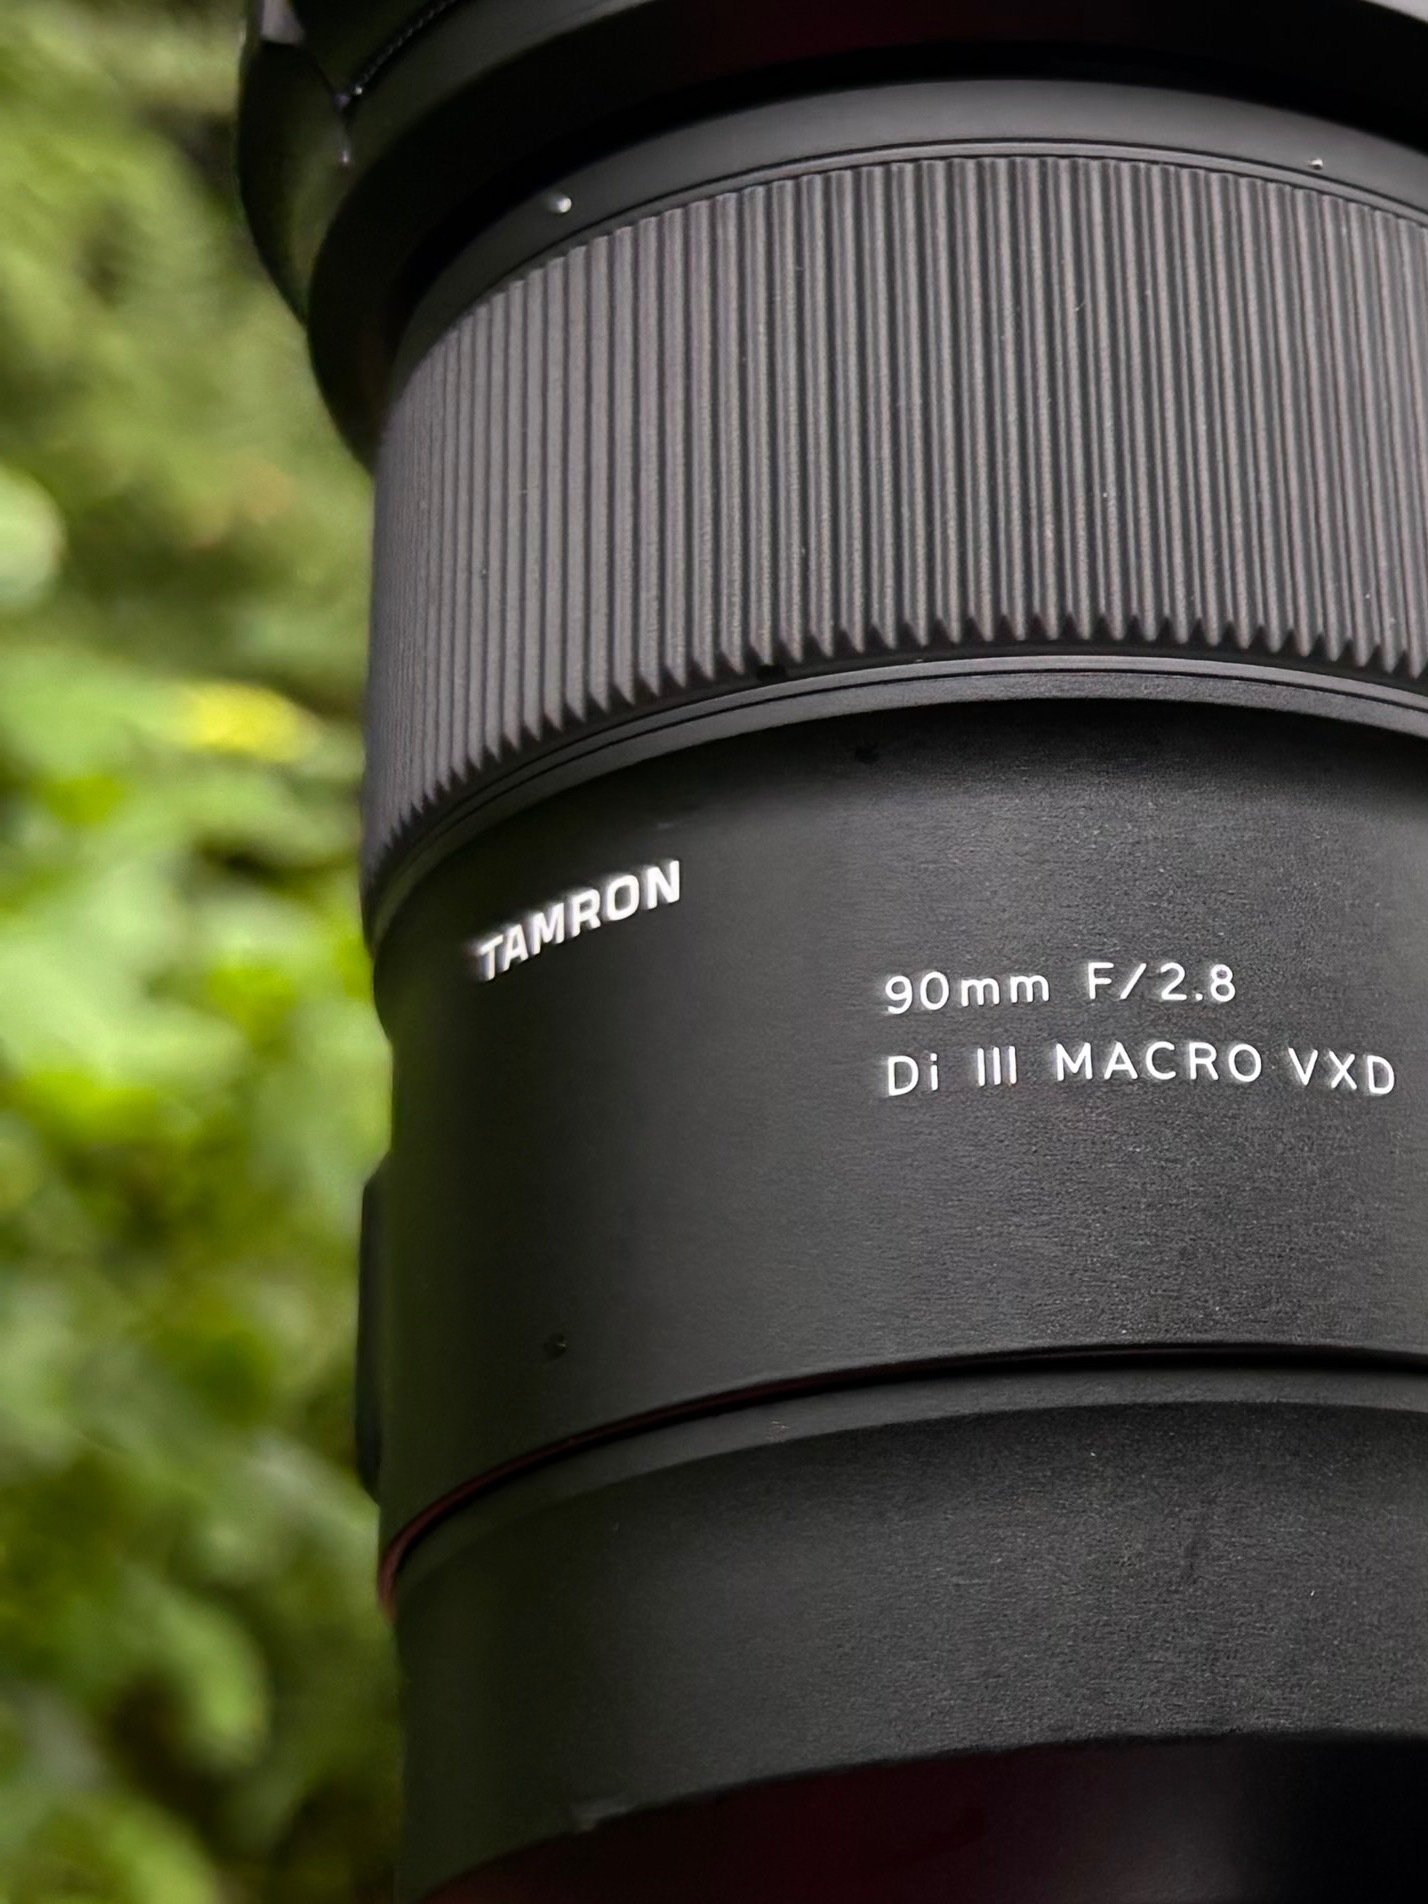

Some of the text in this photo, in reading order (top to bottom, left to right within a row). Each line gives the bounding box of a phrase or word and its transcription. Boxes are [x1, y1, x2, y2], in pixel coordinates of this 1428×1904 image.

[472, 859, 681, 982] TAMRON
[884, 961, 1237, 1015] 90mm F/2.8
[886, 1040, 1396, 1097] Di III MACRO VXD
